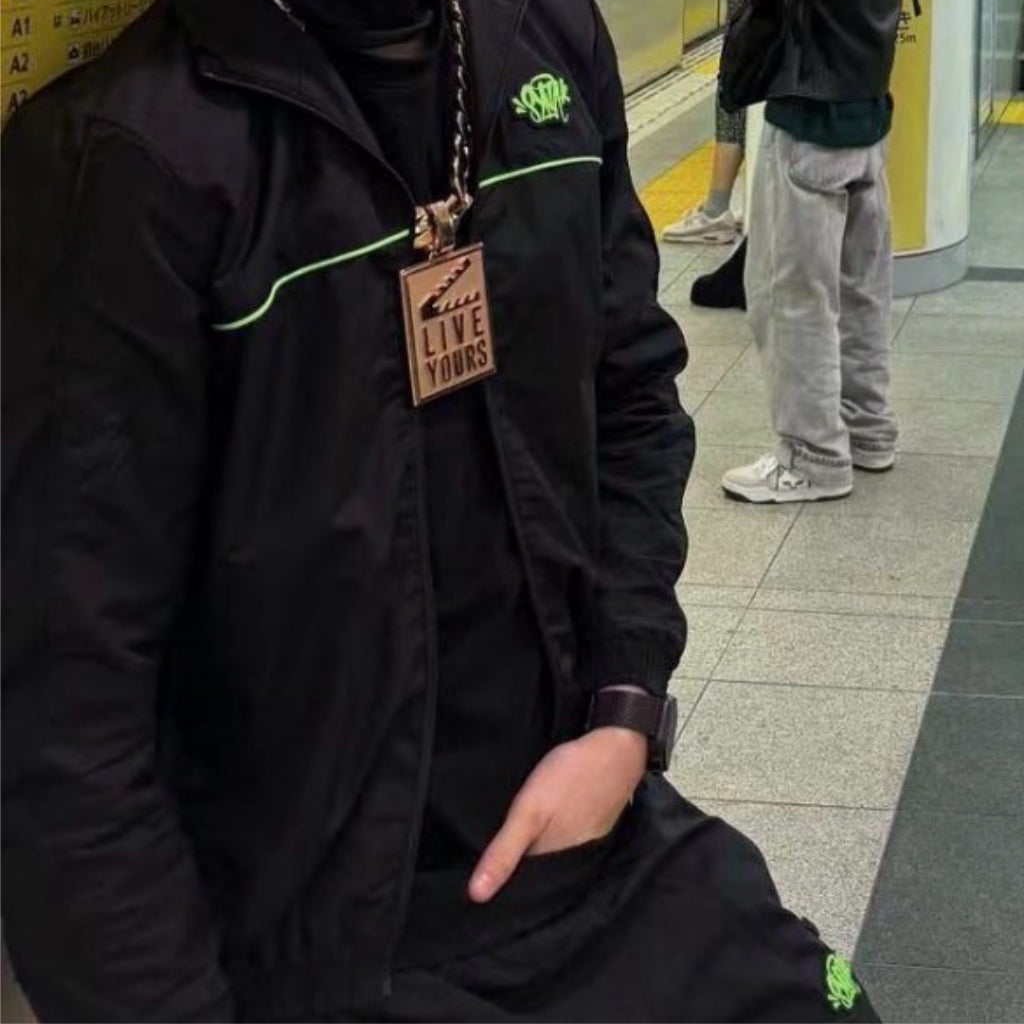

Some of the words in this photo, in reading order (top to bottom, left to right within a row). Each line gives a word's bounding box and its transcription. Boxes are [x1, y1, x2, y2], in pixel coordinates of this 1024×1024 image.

[12, 17, 30, 37] A1
[10, 53, 29, 75] A2
[422, 305, 485, 358] LIVE
[426, 339, 488, 387] YOURS
